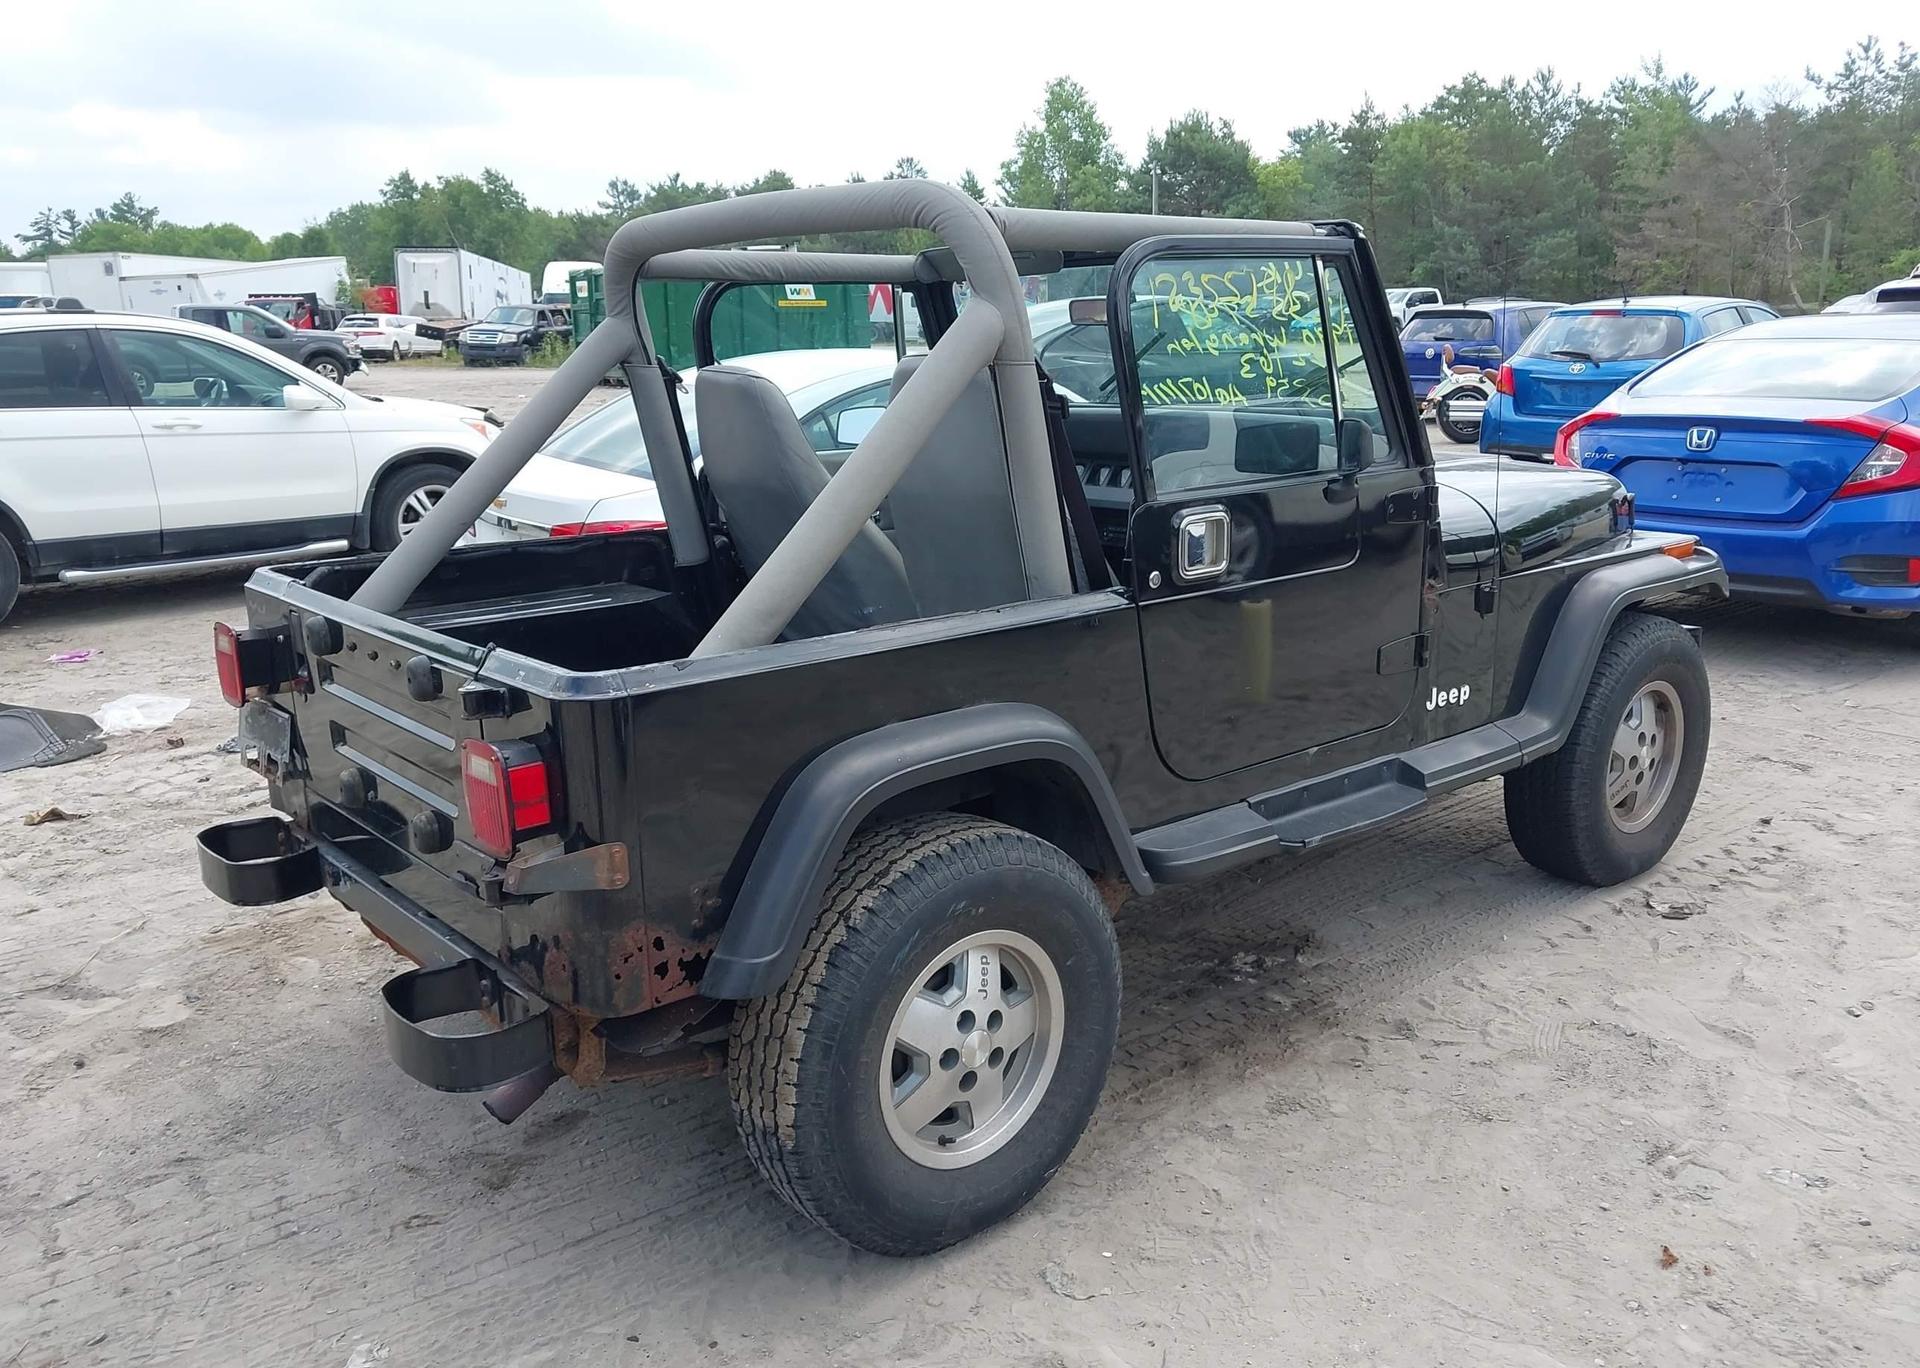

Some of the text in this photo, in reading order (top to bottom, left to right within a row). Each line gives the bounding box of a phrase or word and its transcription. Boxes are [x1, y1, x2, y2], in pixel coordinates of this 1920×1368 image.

[789, 287, 812, 296] WM
[1584, 451, 1616, 460] CIVIC
[1425, 684, 1470, 711] Jeep
[977, 954, 991, 1000] Jeep
